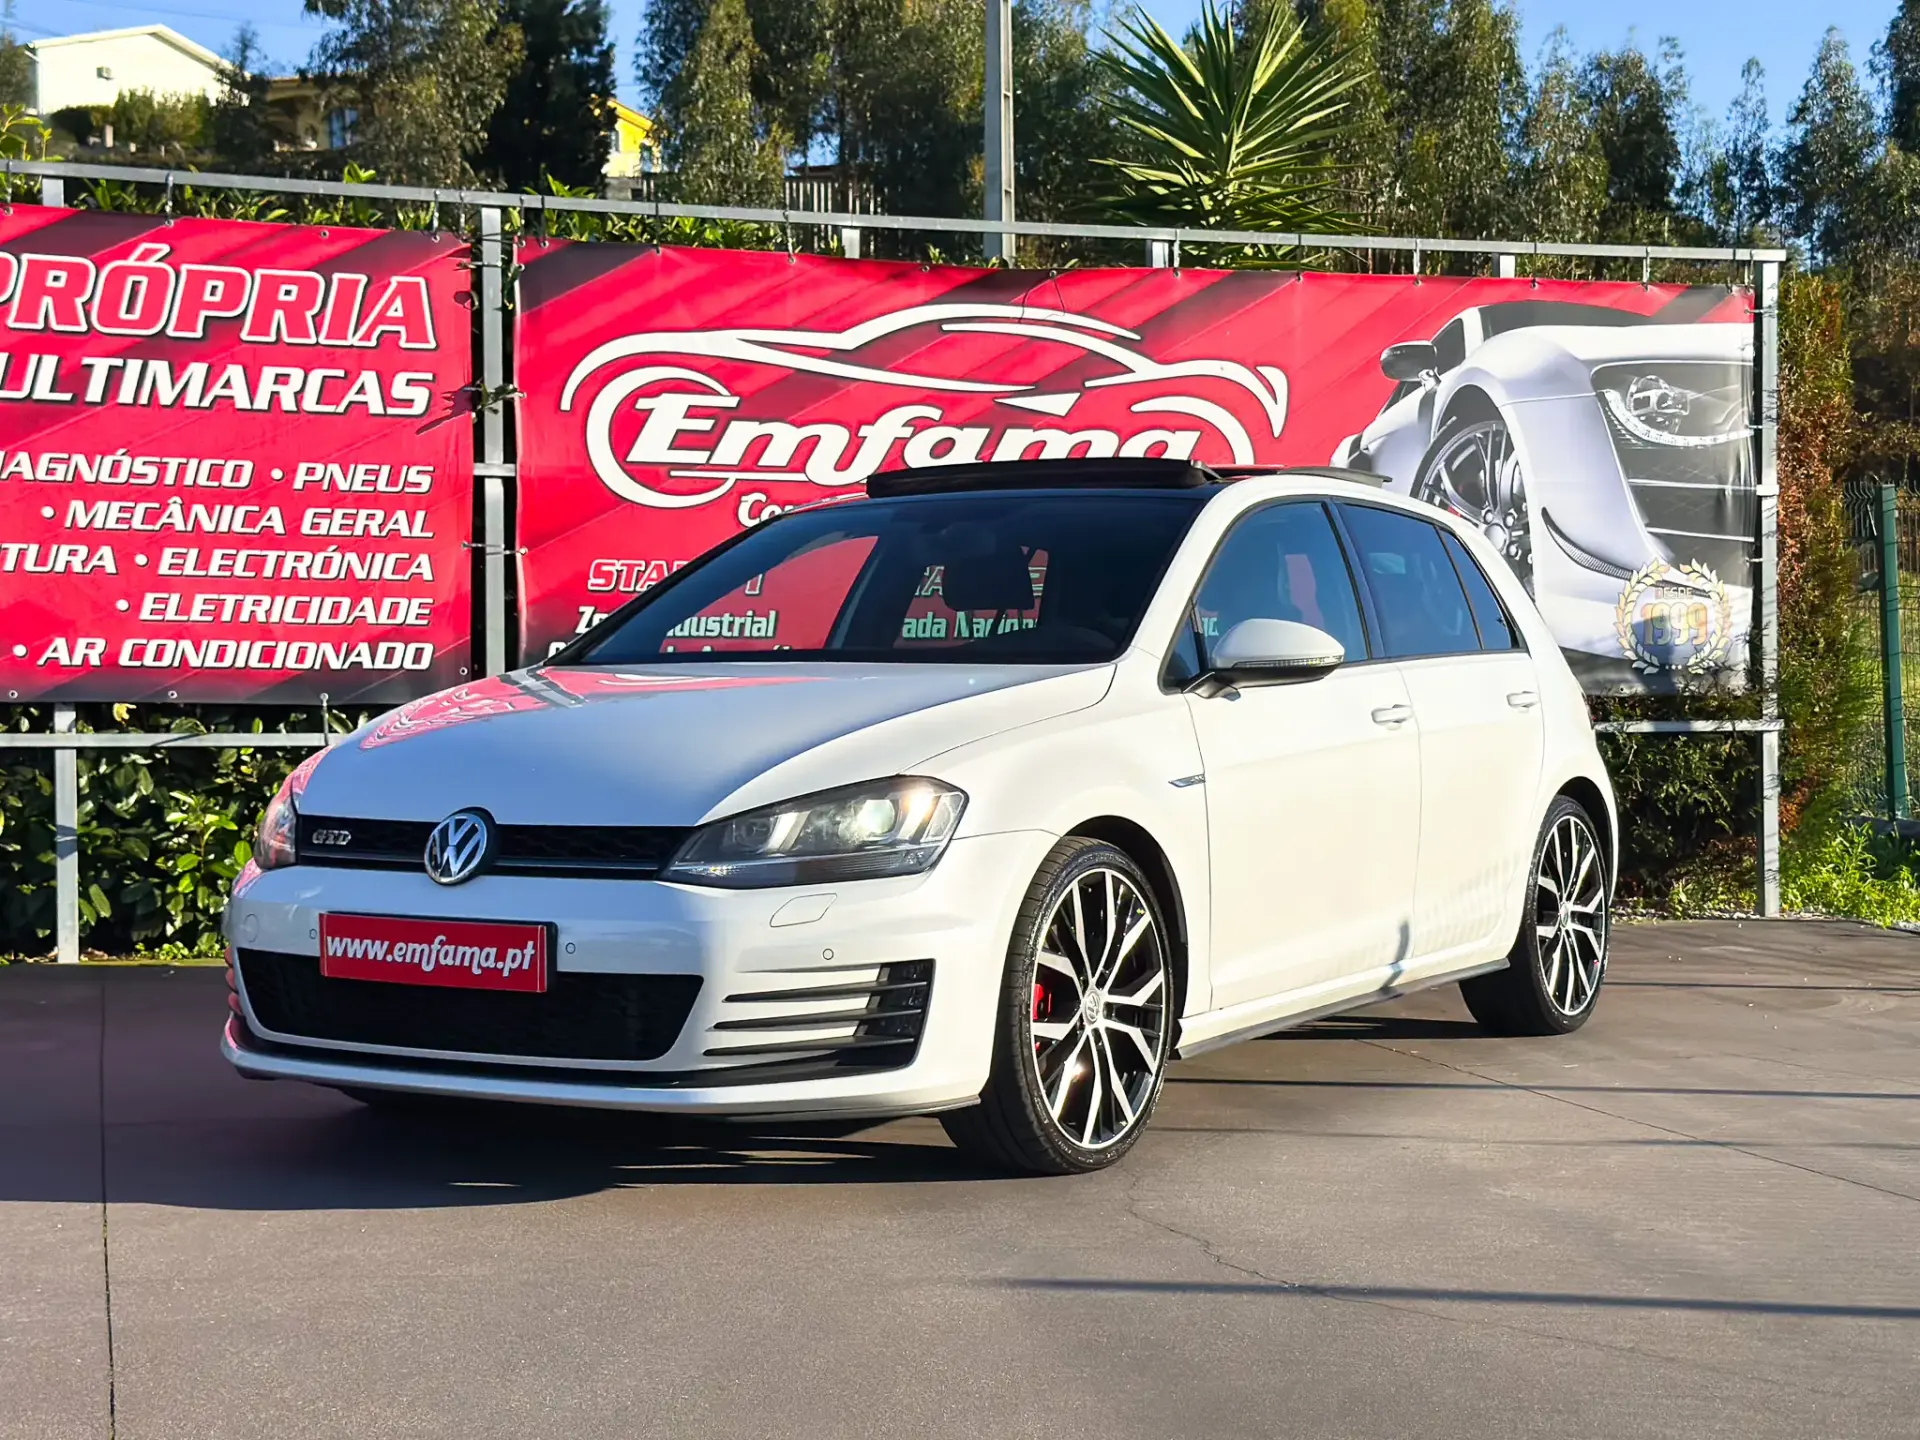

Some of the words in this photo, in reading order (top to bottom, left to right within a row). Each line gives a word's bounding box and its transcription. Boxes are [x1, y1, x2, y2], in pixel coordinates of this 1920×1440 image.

[0, 242, 437, 350] RÓPRIA
[625, 392, 1201, 486] Emfama
[293, 462, 434, 494] PNEUS
[64, 496, 286, 536] MECÂNICA
[301, 508, 434, 539] GERAL
[157, 545, 434, 581] ELECTRÓNICA
[139, 592, 433, 627] ELETRICIDADE
[1641, 601, 1708, 645] 1999
[37, 638, 107, 667] AR
[118, 639, 434, 671] CONDICIONADO
[312, 829, 352, 845] GTD
[326, 935, 535, 977] www.emfama.pt
